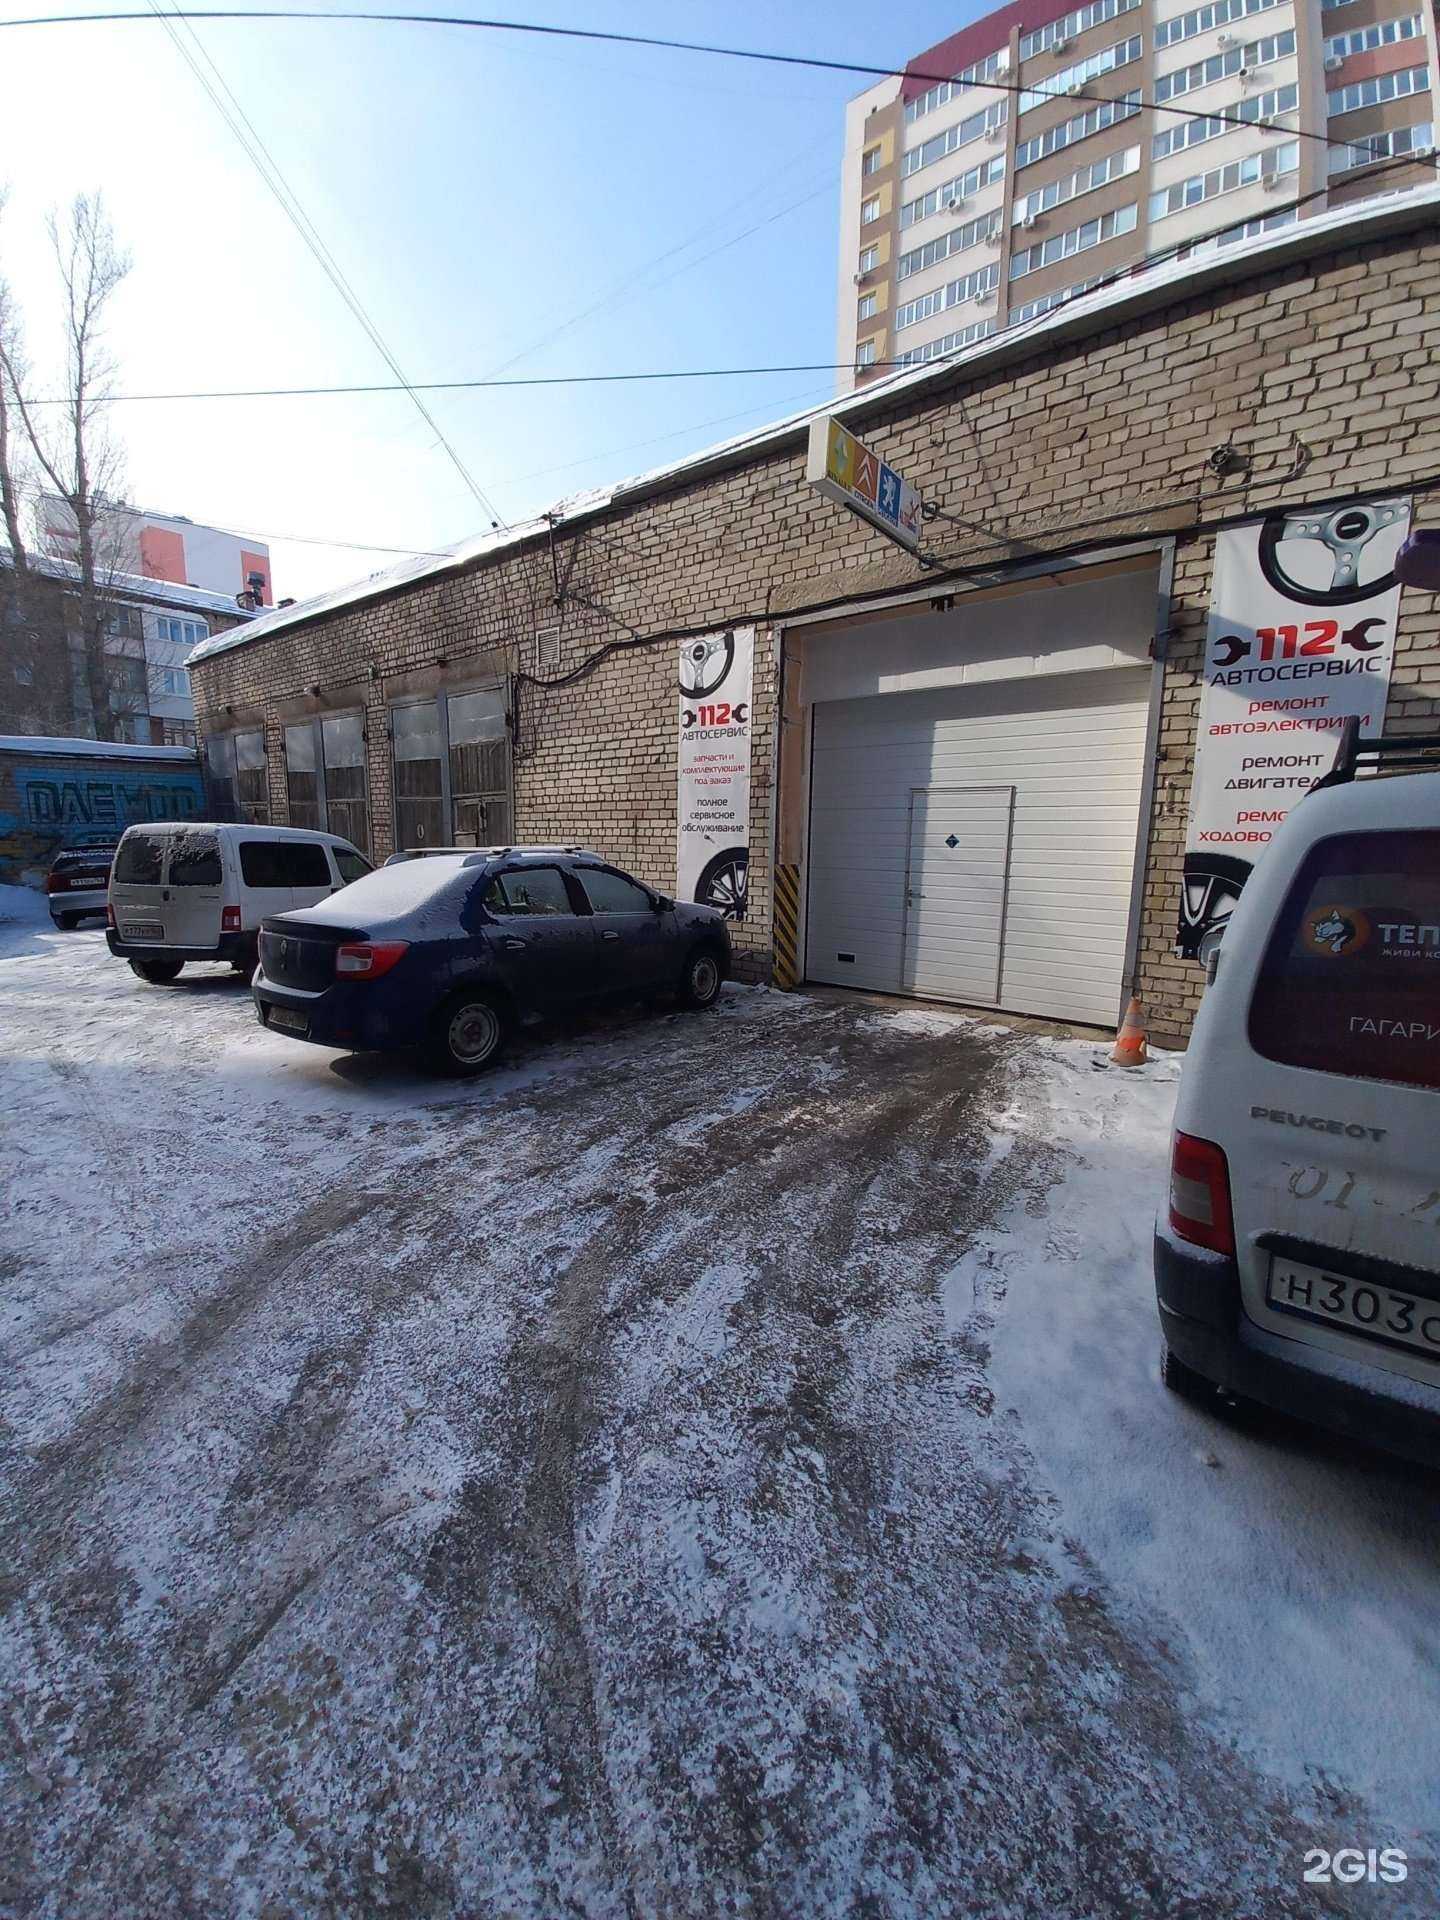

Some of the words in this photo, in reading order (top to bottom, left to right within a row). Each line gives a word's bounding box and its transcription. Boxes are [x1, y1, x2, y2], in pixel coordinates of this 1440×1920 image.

[1256, 620, 1338, 661] 112
[1210, 656, 1383, 687] АВТОСЕРВИС
[1248, 696, 1329, 716] ремонт
[698, 703, 731, 727] 112
[1209, 714, 1370, 736] автоэлектрии
[682, 726, 748, 741] АВТОСЕРВИС
[694, 754, 728, 763] запчасти
[1242, 755, 1324, 772] ремонт
[682, 764, 746, 775] комплектующие
[709, 777, 732, 785] заказ
[697, 798, 728, 807] полное
[689, 811, 735, 821] сервисное
[681, 822, 745, 833] обслуживание
[1251, 1105, 1387, 1143] PEUGEOT
